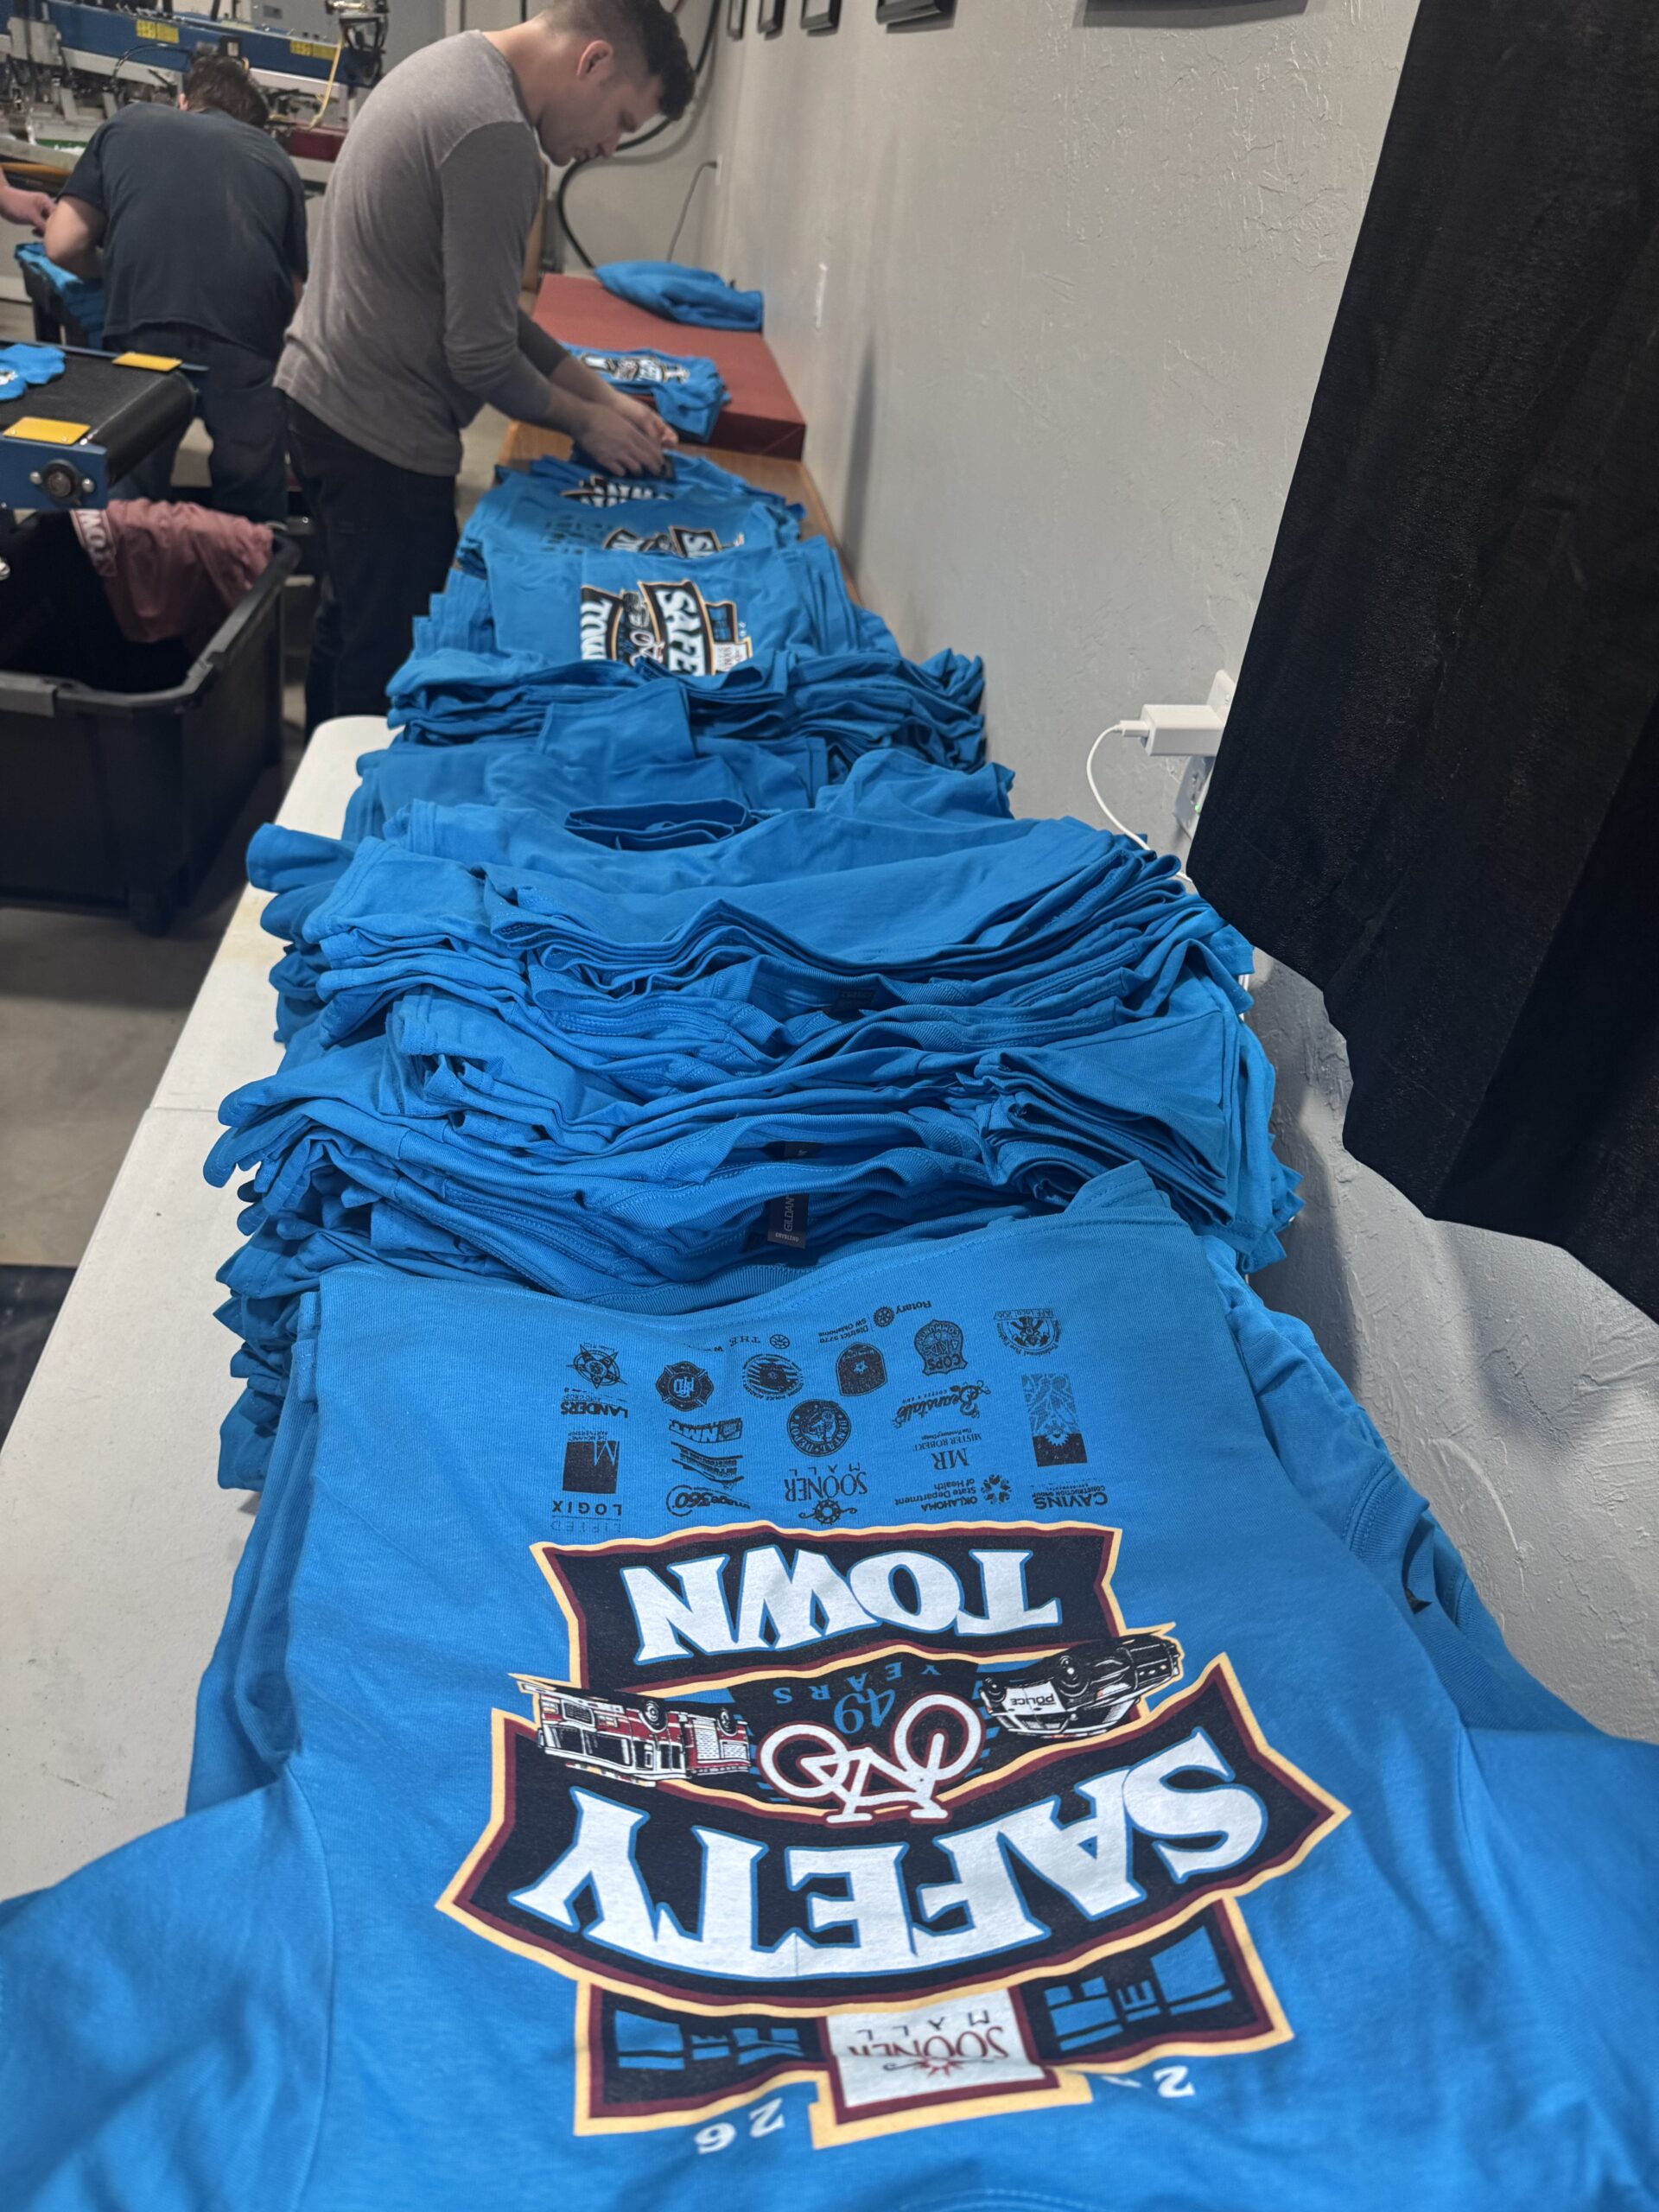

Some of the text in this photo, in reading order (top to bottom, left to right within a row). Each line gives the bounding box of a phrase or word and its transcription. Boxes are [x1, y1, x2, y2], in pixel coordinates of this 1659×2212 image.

[784, 1197, 795, 1231] GILDAN
[894, 1300, 932, 1314] Rotary
[817, 1318, 867, 1337] SW Oklahoma
[840, 1325, 868, 1340] District
[729, 1335, 760, 1347] THE
[923, 1340, 950, 1356] KIDS
[927, 1353, 961, 1370] COPS
[560, 1402, 628, 1419] LANDERS
[896, 1385, 982, 1424] Beanstalk
[790, 1420, 848, 1452] DENTAL DEPOT
[912, 1433, 982, 1452] MISTER ROBERT
[931, 1447, 970, 1471] MR
[789, 1462, 860, 1477] MALL
[784, 1471, 868, 1502] SOONER
[933, 1478, 975, 1491] of Health
[1056, 1485, 1105, 1497] CONSTRUCTION
[894, 1487, 976, 1506] State Department
[921, 1497, 977, 1512] OKLAHOMA
[1033, 1491, 1108, 1510] CAVINS
[552, 1500, 622, 1516] LOGIX
[620, 1546, 1061, 1665] TOWN
[772, 1662, 941, 1704] YEARS
[1010, 1693, 1055, 1706] POLICE
[833, 1688, 896, 1735] 49
[508, 1729, 1267, 1978] SAFETY
[856, 2010, 989, 2040] MALL
[694, 2097, 785, 2155] 26
